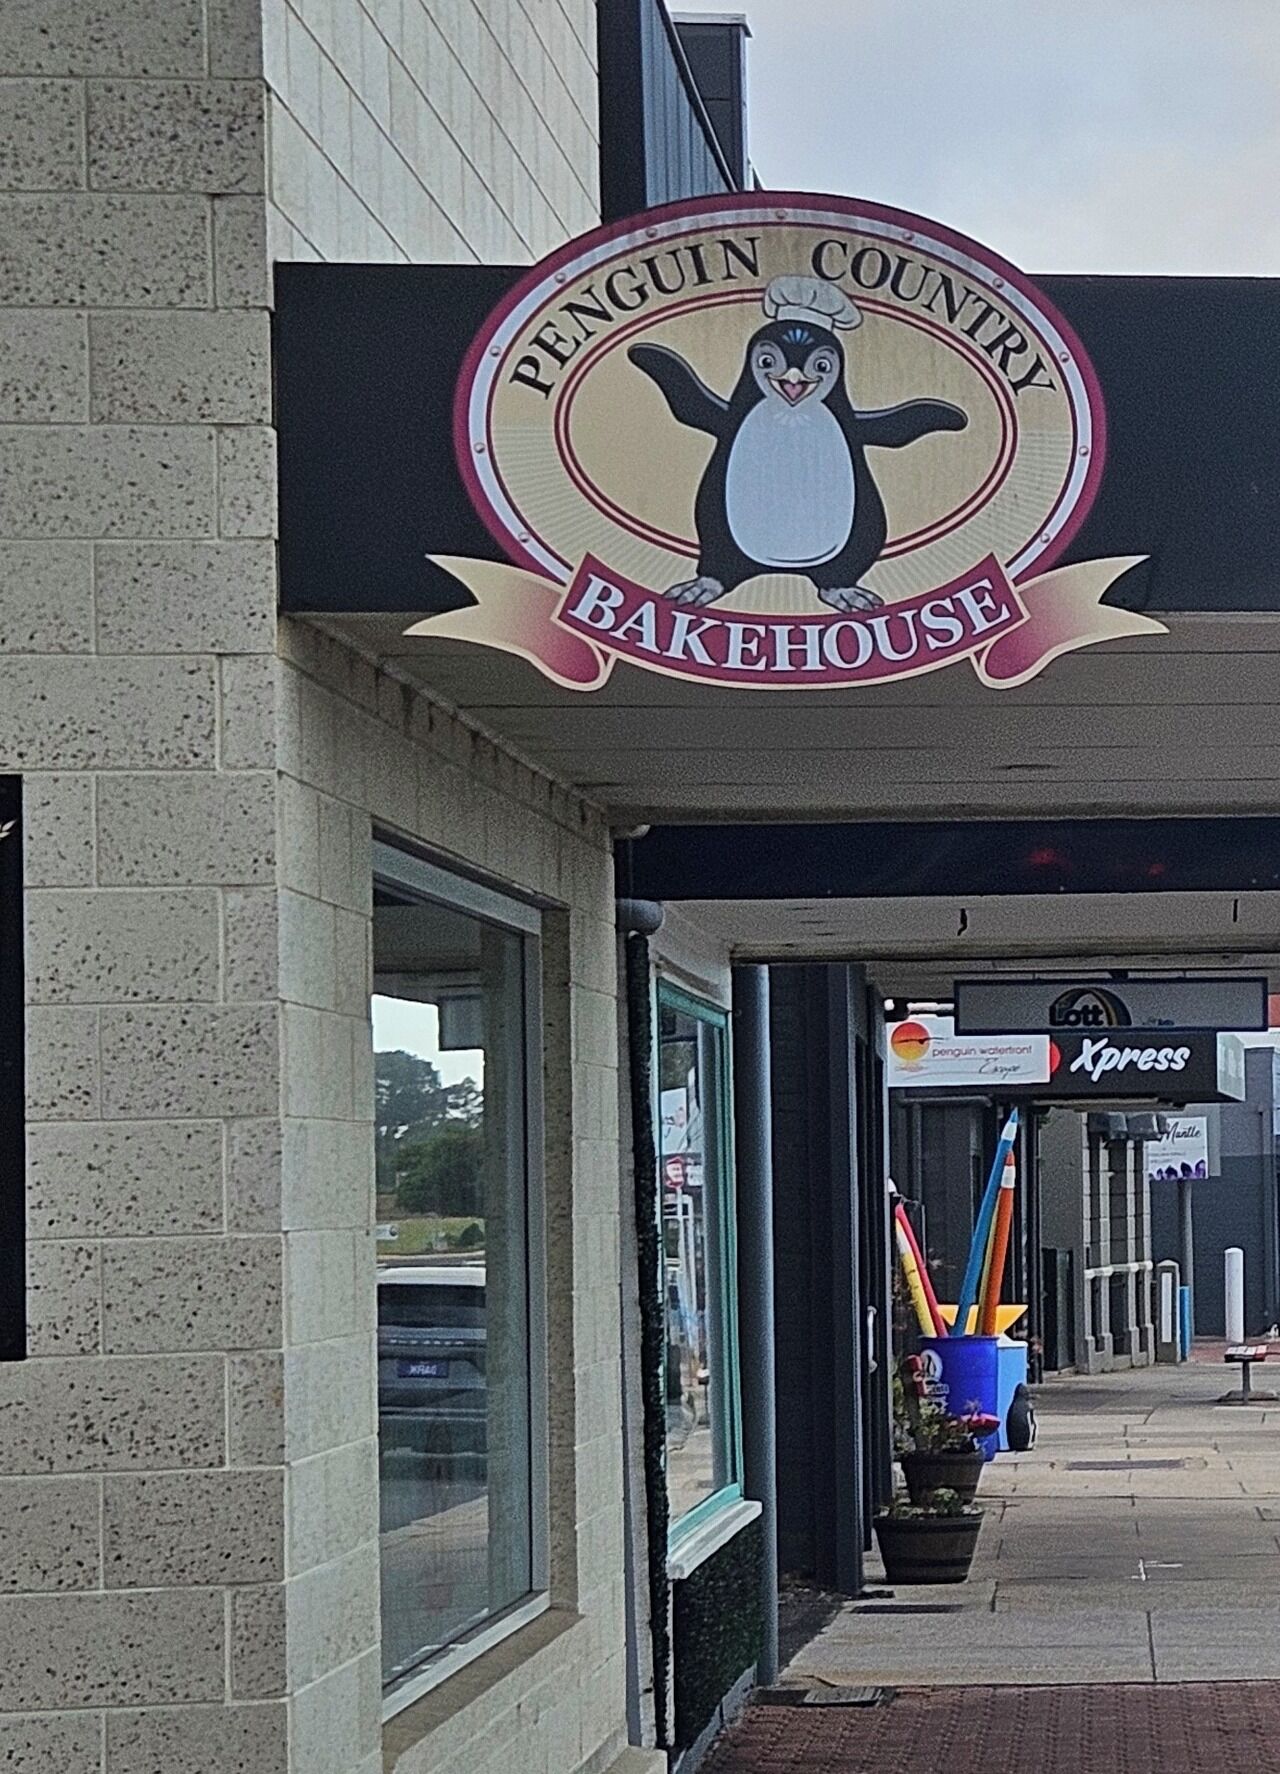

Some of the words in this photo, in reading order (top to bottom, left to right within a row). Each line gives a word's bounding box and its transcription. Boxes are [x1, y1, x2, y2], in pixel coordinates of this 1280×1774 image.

[509, 236, 762, 400] PENGUIN
[811, 238, 1058, 398] COUNTRY
[567, 574, 1012, 672] BAKEHOUSE
[932, 1047, 977, 1058] penguin
[980, 1045, 1032, 1056] waterfront
[1070, 1037, 1191, 1083] Xpress
